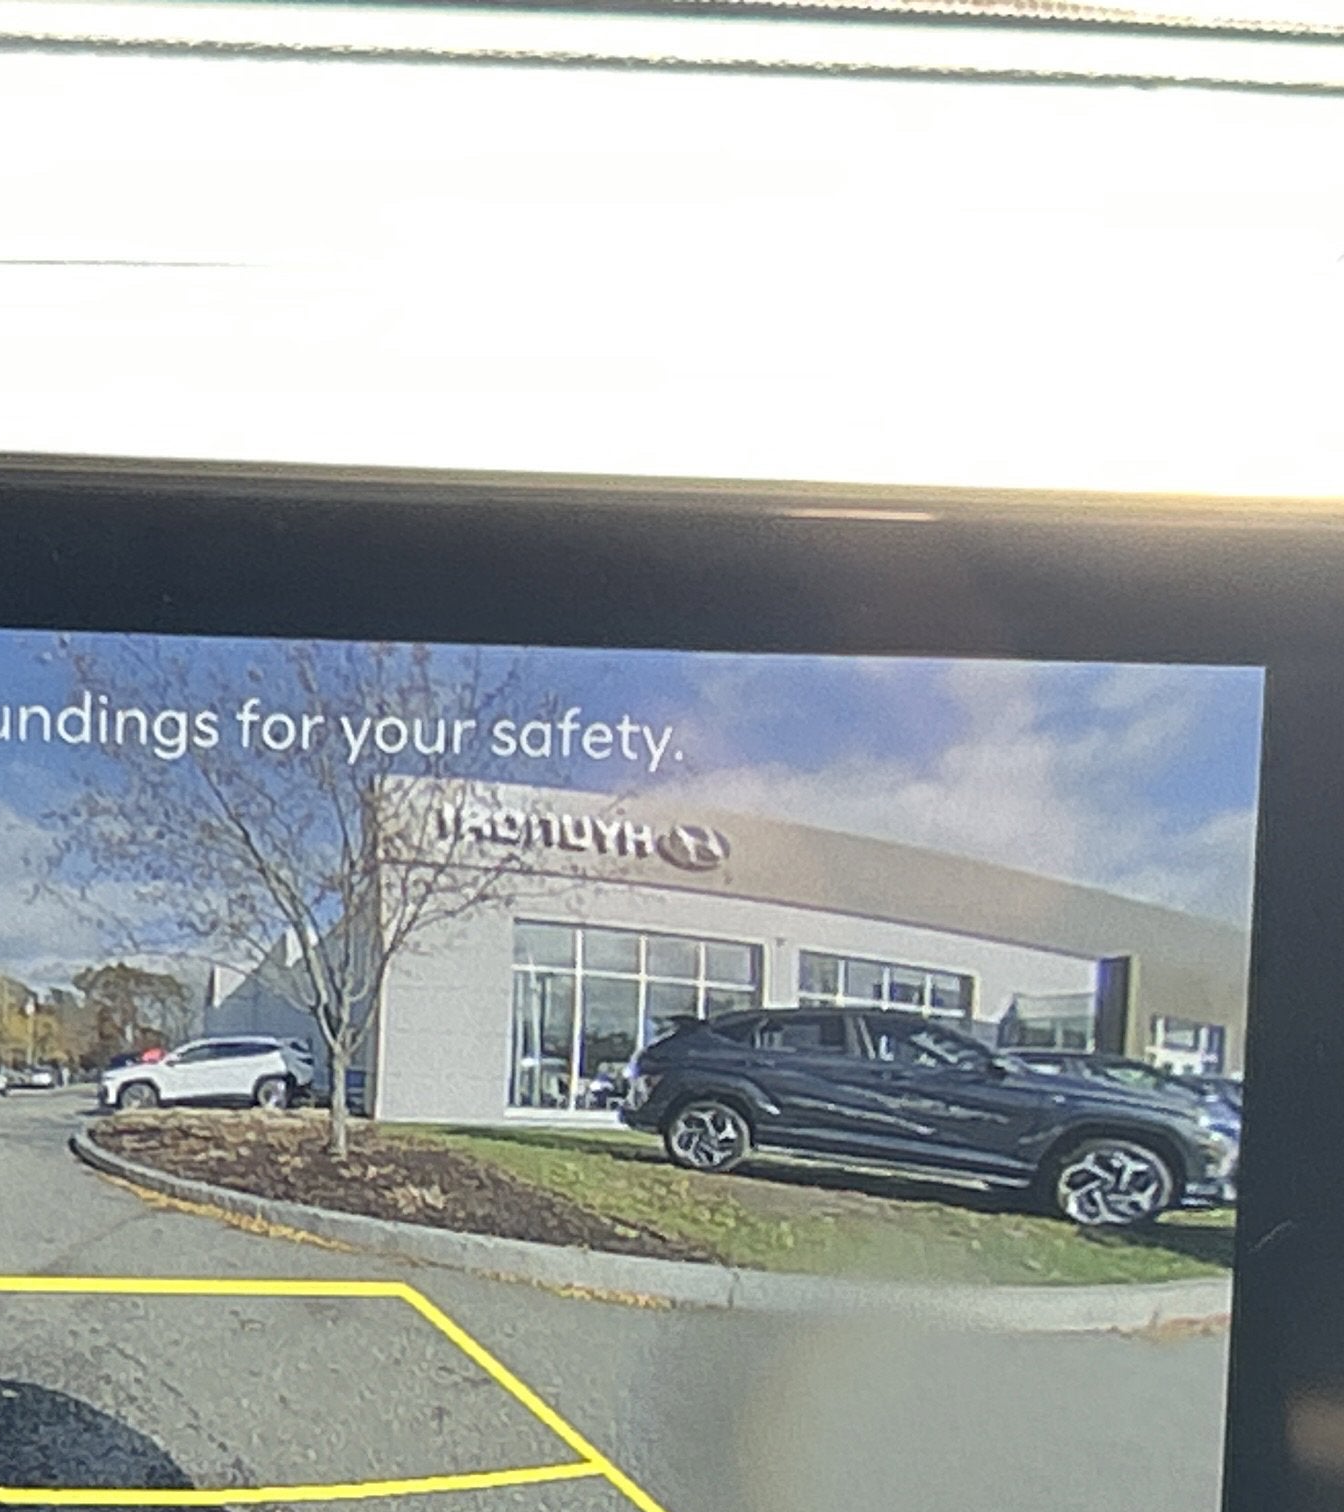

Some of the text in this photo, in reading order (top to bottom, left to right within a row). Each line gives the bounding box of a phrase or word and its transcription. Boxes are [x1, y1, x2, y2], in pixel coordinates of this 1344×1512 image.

[236, 698, 324, 750] for
[340, 713, 476, 764] your
[491, 707, 685, 772] safety.
